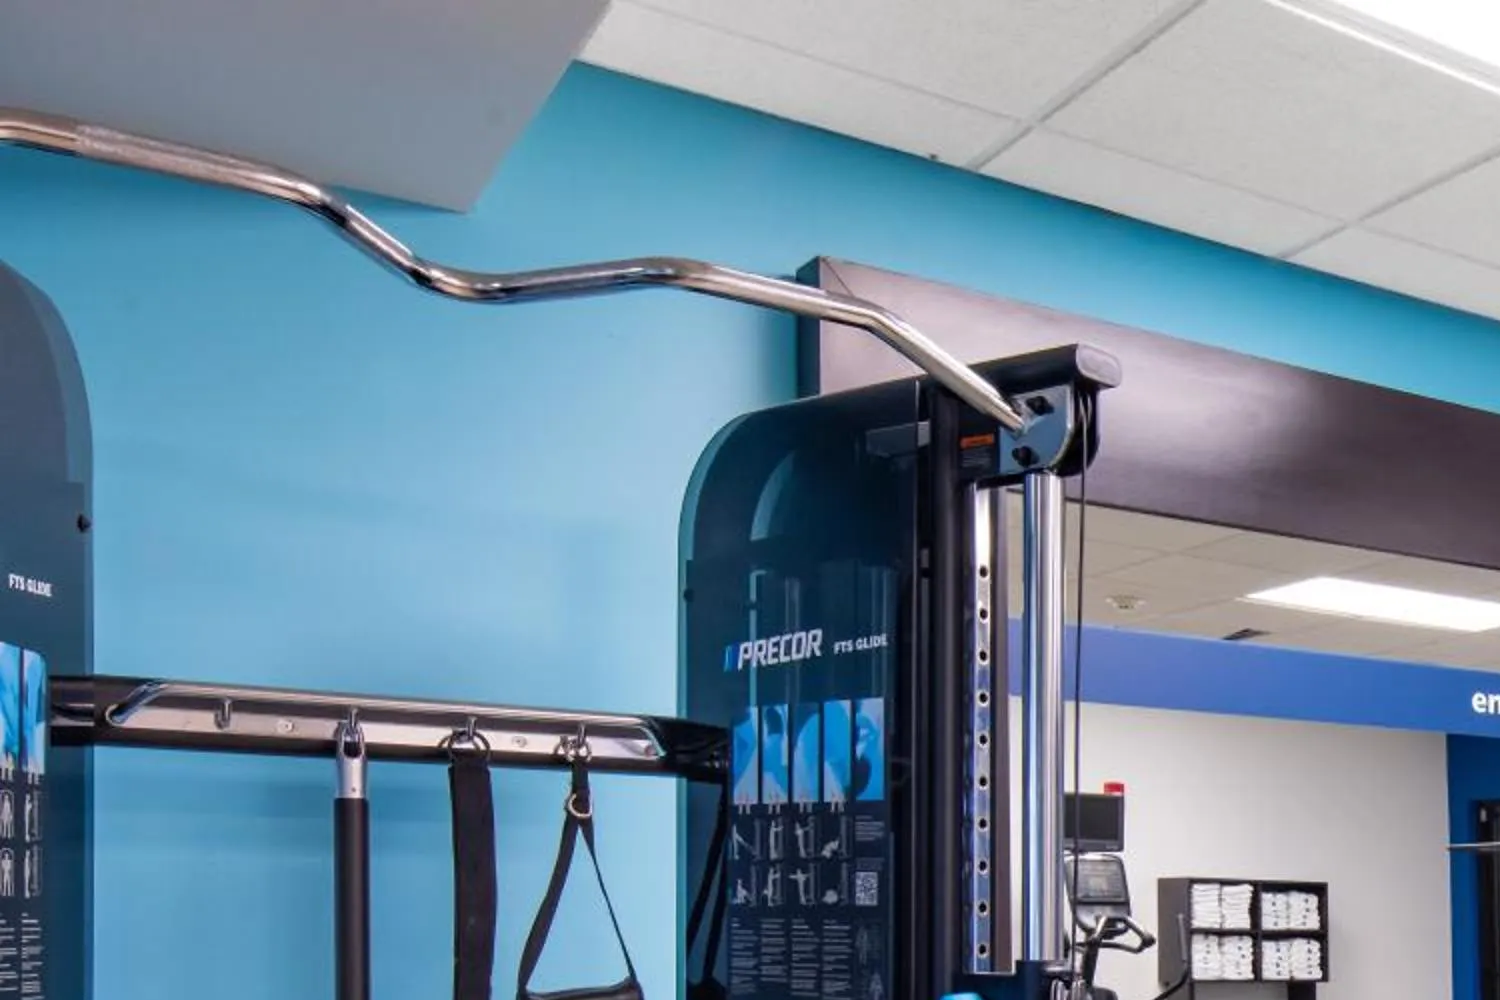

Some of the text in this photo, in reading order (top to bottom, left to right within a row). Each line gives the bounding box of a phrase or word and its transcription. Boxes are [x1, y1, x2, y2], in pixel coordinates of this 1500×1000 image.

[8, 573, 52, 597] FTS GLIDE
[737, 629, 823, 671] PRECOR
[833, 633, 889, 655] FTS GLIDE
